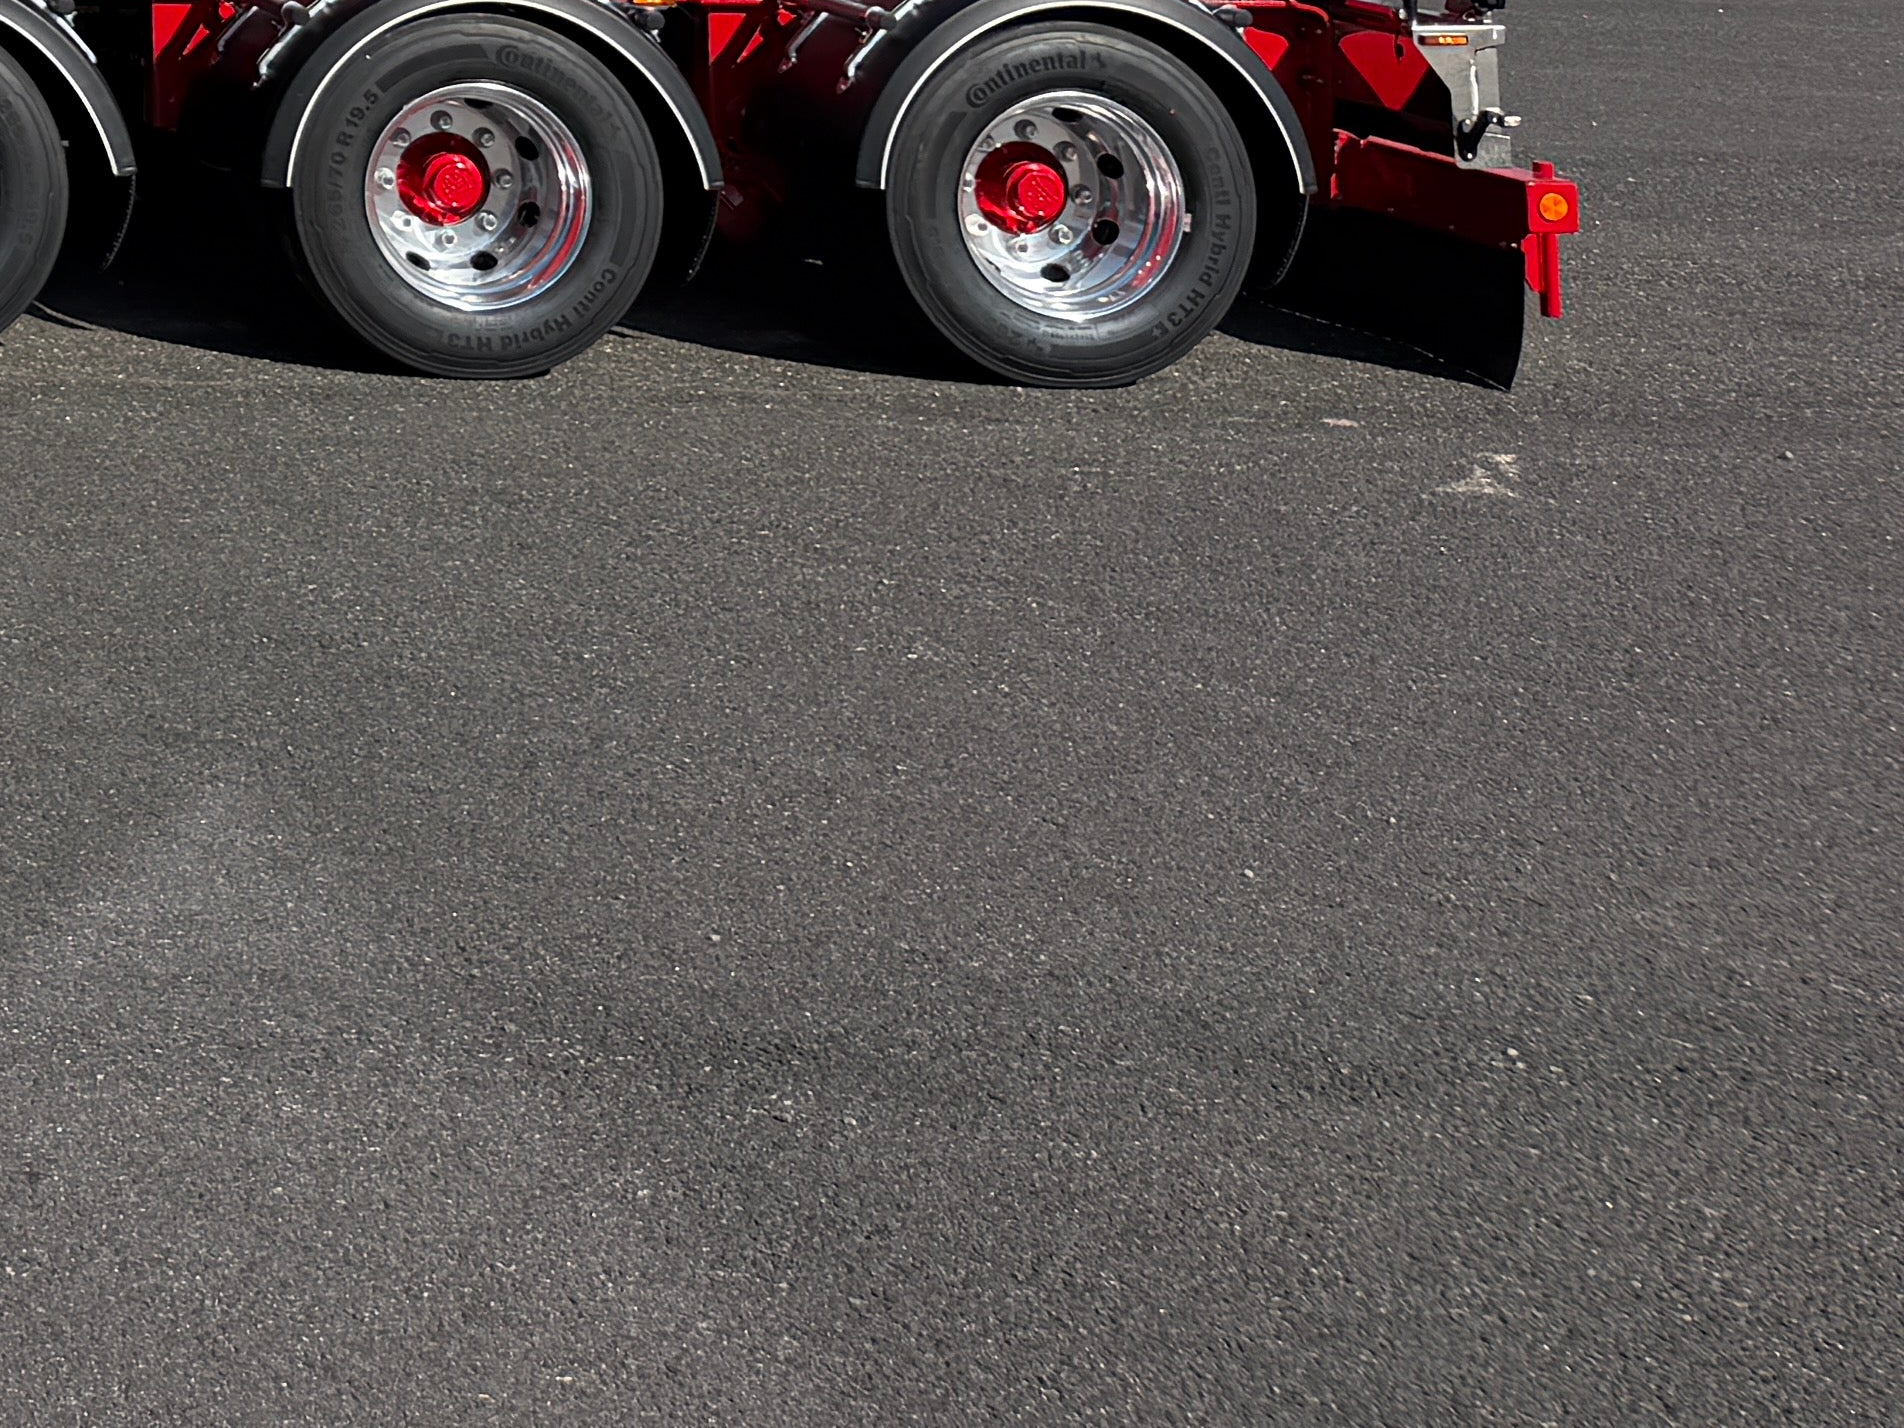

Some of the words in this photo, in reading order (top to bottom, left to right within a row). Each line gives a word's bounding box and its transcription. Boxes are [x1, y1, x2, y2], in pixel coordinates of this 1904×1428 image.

[965, 49, 1087, 109] Continental
[345, 88, 380, 129] 19.5
[1198, 213, 1232, 287] Hybrid
[571, 267, 618, 321] Conti
[500, 313, 573, 351] Hybrid
